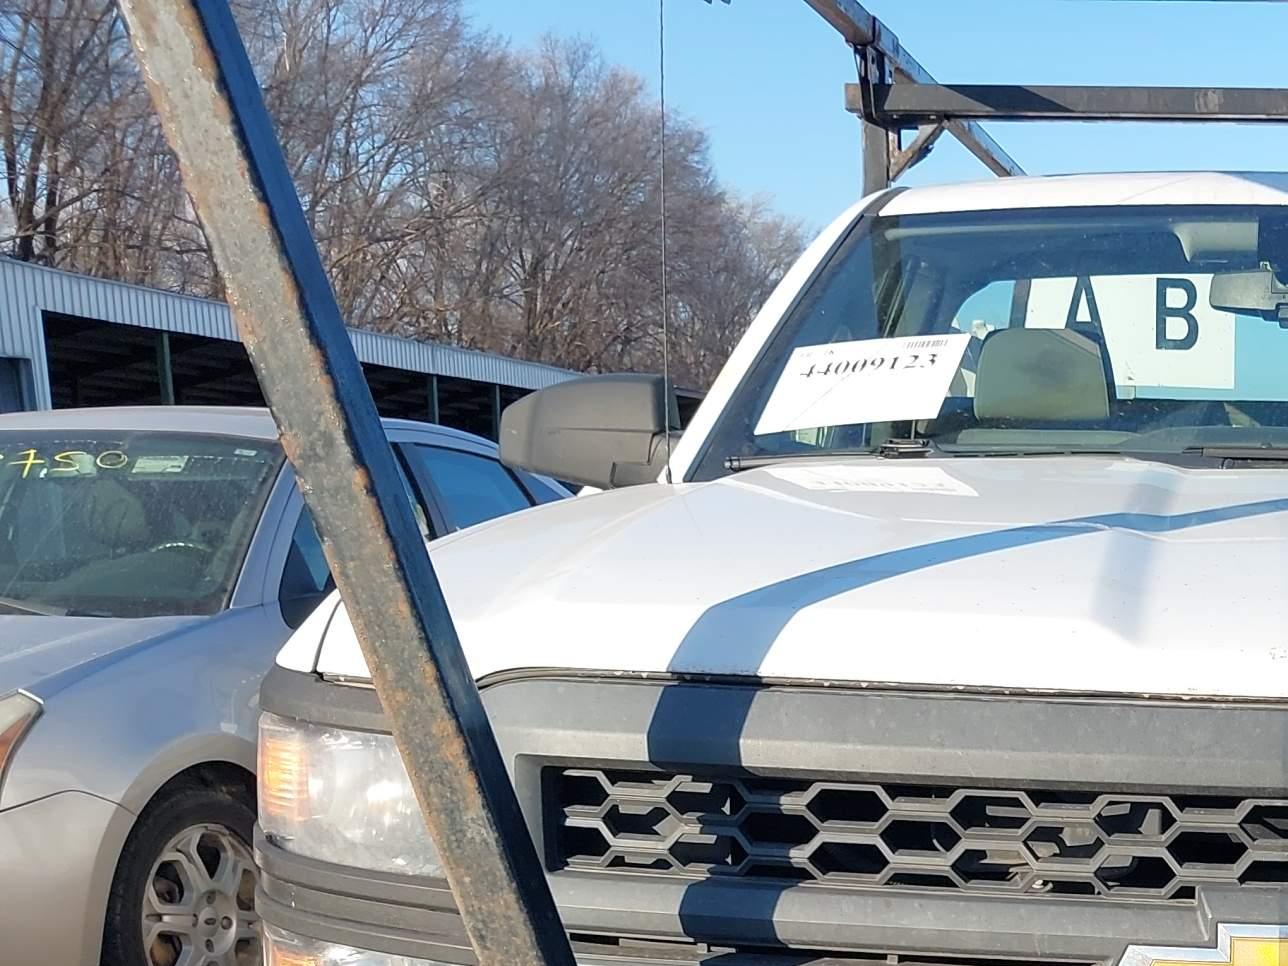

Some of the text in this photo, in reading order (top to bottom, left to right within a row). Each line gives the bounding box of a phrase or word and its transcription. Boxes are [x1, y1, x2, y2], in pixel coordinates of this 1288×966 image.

[1064, 275, 1199, 350] A B
[799, 353, 938, 378] 44009123
